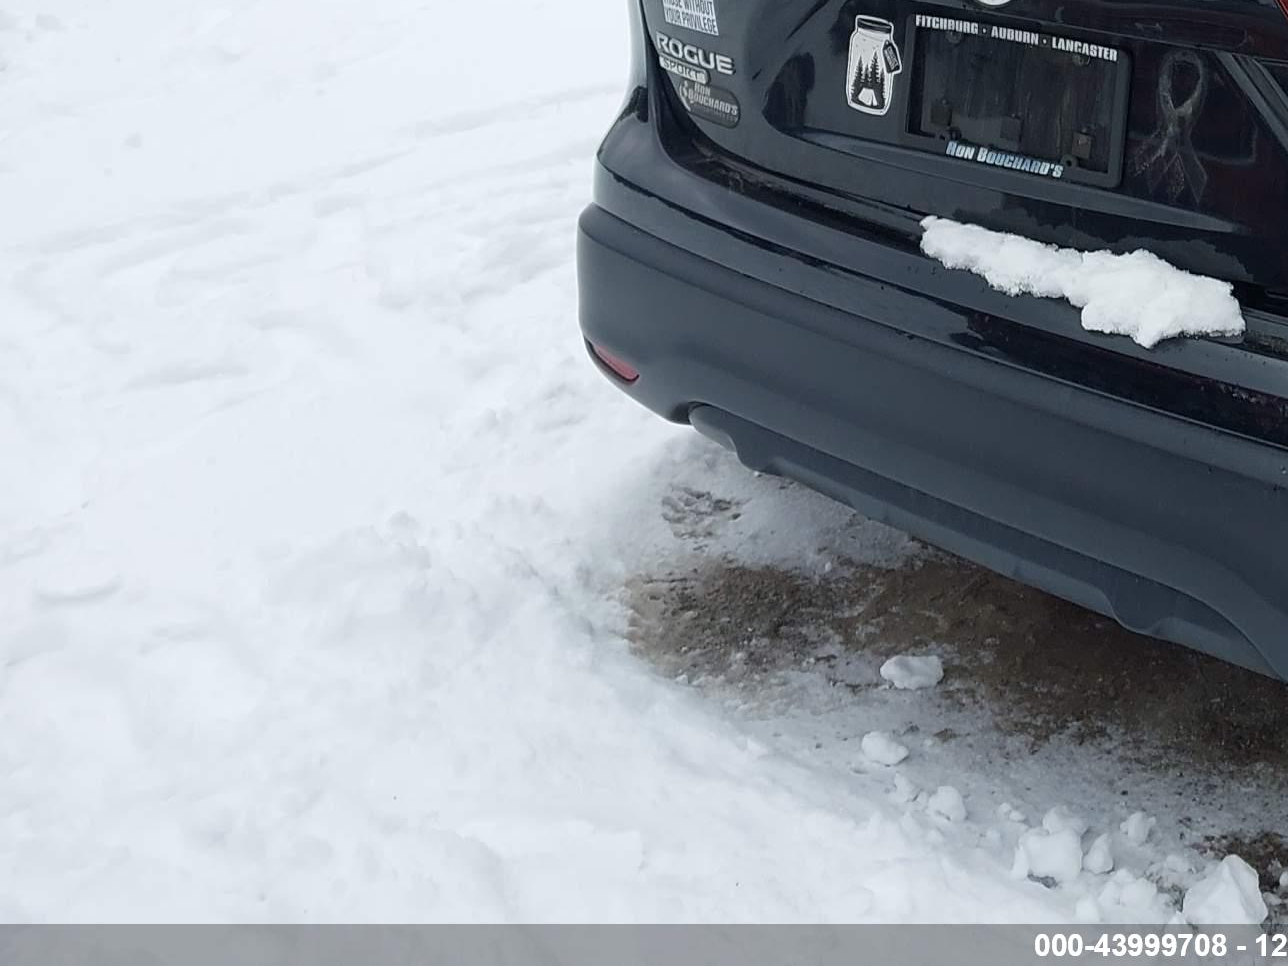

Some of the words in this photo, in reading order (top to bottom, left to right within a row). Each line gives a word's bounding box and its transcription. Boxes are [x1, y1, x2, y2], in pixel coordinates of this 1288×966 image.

[665, 7, 682, 25] YOUR
[681, 11, 718, 34] PRIVILEGE
[656, 31, 735, 75] ROGUE
[915, 14, 979, 35] FITCHBURG
[990, 25, 1039, 45] AUBURN
[1051, 36, 1118, 62] LANCASTER
[662, 56, 698, 81] SPORT
[688, 88, 738, 116] BOUCHARD'S
[945, 140, 975, 160] RON
[977, 146, 1063, 178] BOUCHARD'S
